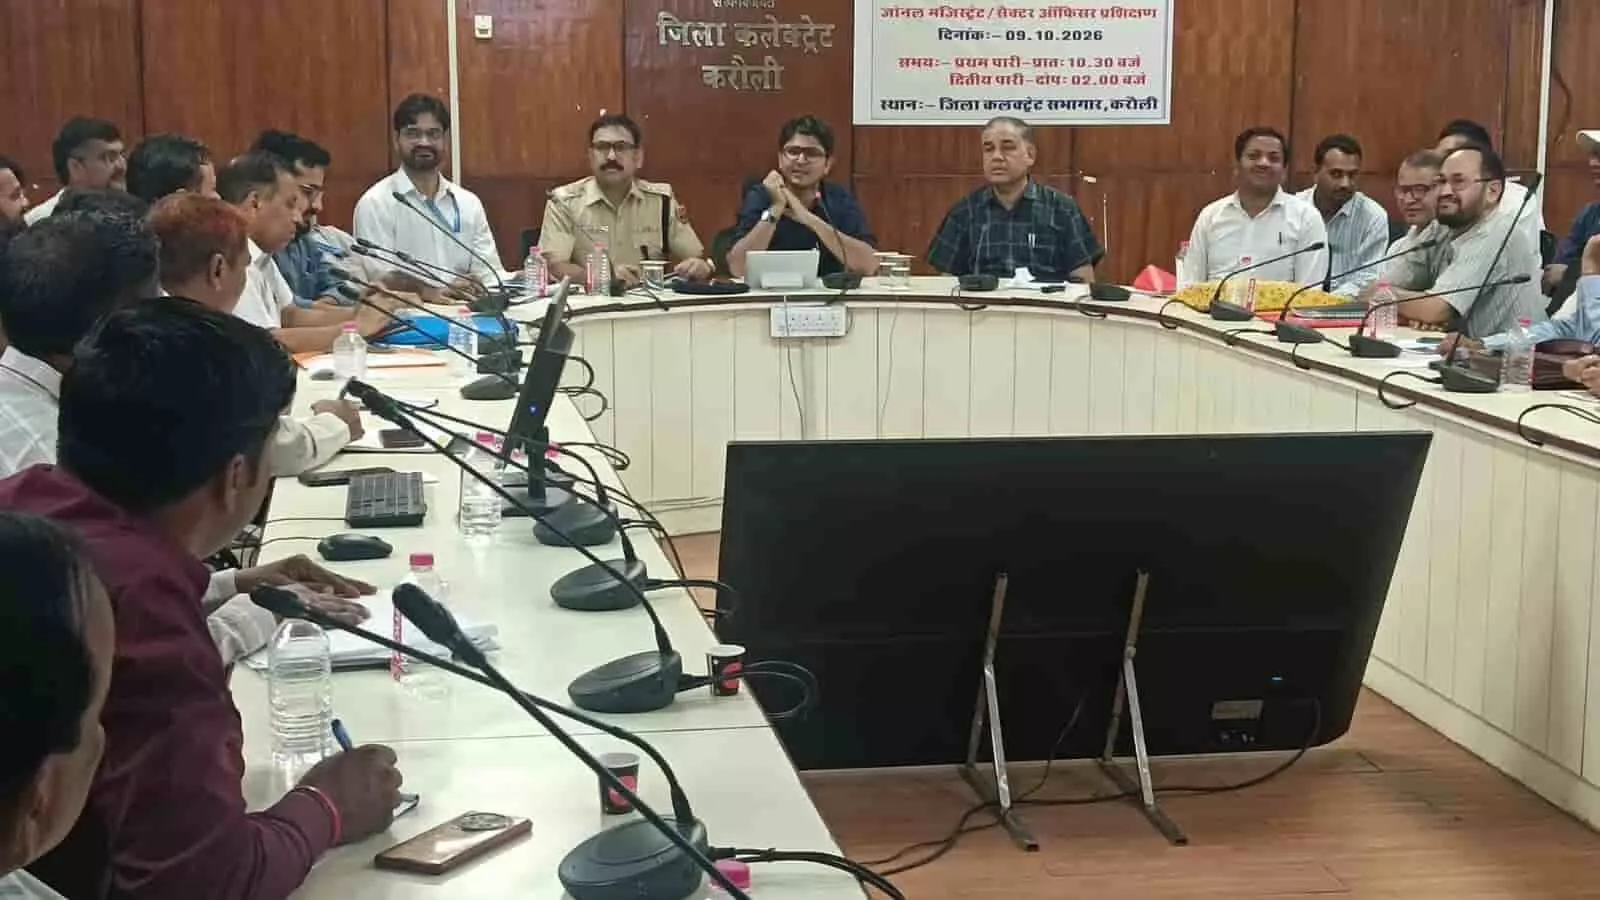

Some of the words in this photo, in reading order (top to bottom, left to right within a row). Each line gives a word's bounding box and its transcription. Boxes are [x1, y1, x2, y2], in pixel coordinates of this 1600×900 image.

[1100, 5, 1158, 19] प्रशिक्षण
[656, 10, 727, 48] जिला
[1006, 30, 1103, 41] 09.10.2026
[954, 56, 988, 69] प्रथम
[1068, 57, 1113, 68] 10.30
[1117, 54, 1141, 68] बजे
[701, 54, 785, 91] करौली
[1071, 74, 1119, 86] 02.00
[1122, 71, 1146, 86] बजे
[939, 96, 979, 111] जिला
